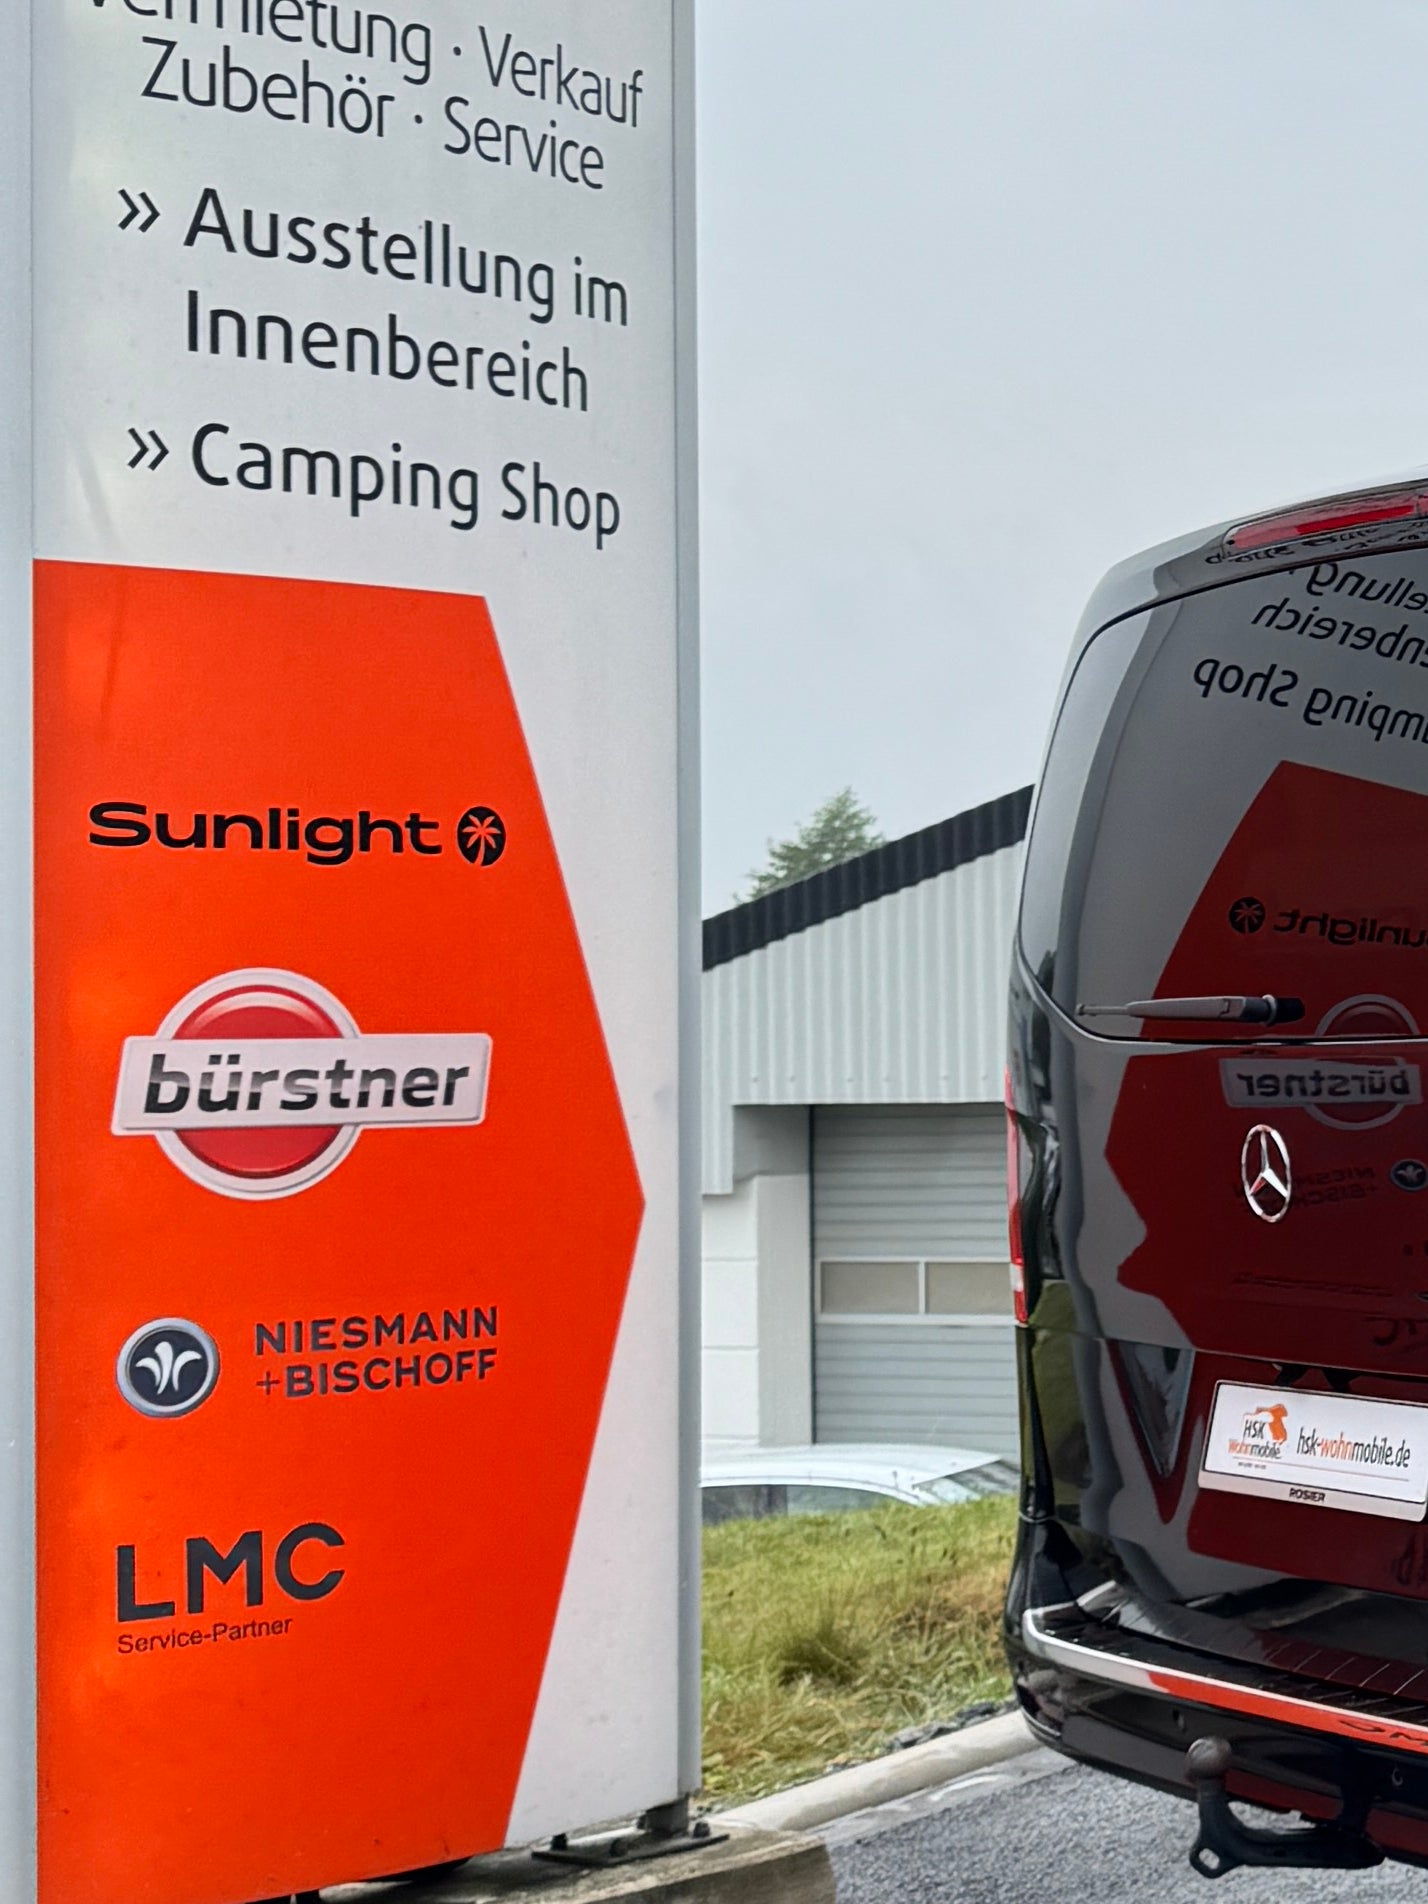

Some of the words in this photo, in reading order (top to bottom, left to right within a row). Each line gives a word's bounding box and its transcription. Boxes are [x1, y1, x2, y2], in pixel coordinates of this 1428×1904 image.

[479, 26, 643, 128] Verkauf
[140, 36, 395, 138] Zubehör
[443, 97, 604, 189] Service
[183, 187, 554, 324] Ausstellung
[573, 257, 627, 326] im
[187, 290, 588, 412] Innenbereich
[191, 423, 478, 531] Camping
[501, 461, 620, 550] Shop
[88, 802, 442, 865] Sunlight
[144, 1054, 470, 1114] bürstner
[256, 1306, 498, 1356] NIESMANN
[256, 1349, 497, 1398] +BISCHOFF
[1244, 1420, 1266, 1439] HSK
[1297, 1427, 1410, 1468] hsk-wohnmobile.de
[116, 1522, 346, 1622] LMC
[117, 1617, 292, 1655] Service-Partner
